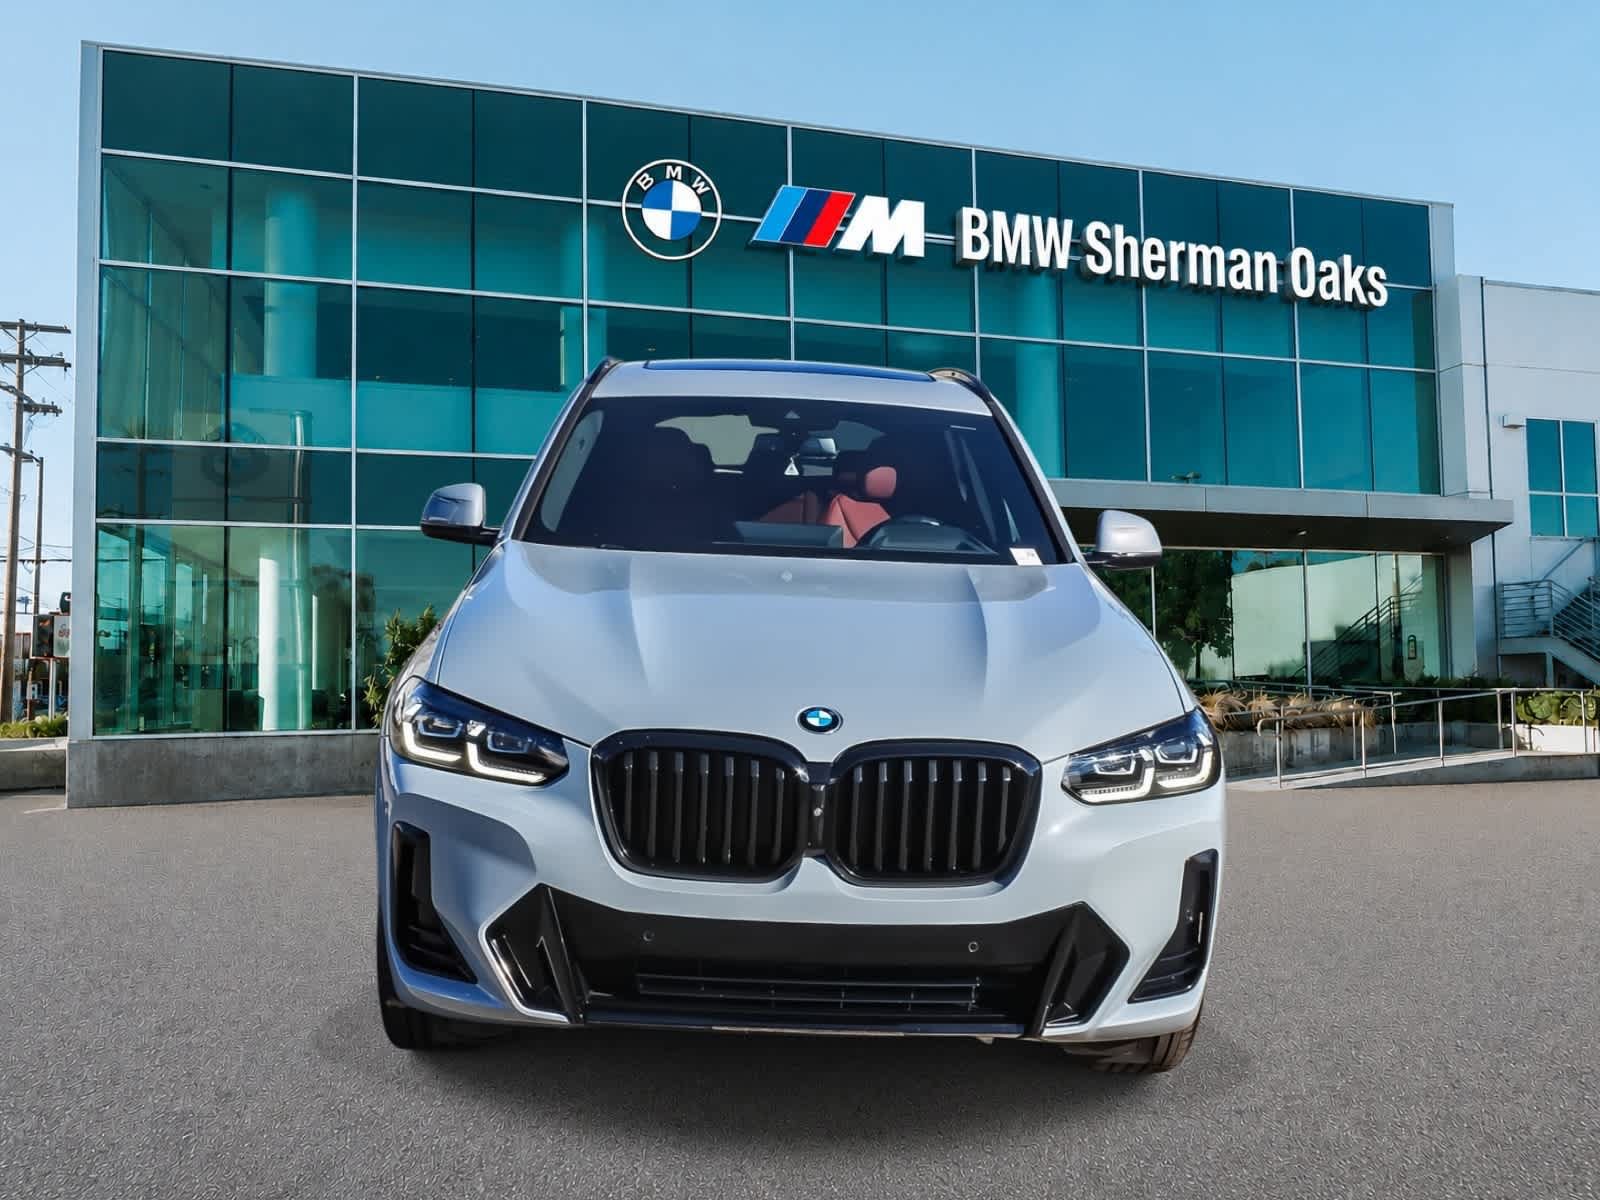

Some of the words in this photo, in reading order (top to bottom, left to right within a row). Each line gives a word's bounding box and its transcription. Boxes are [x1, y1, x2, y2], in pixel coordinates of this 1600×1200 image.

[636, 165, 711, 194] BMW
[960, 206, 1074, 269] BMW
[1085, 220, 1279, 294] Sherman
[1290, 247, 1388, 307] Oaks
